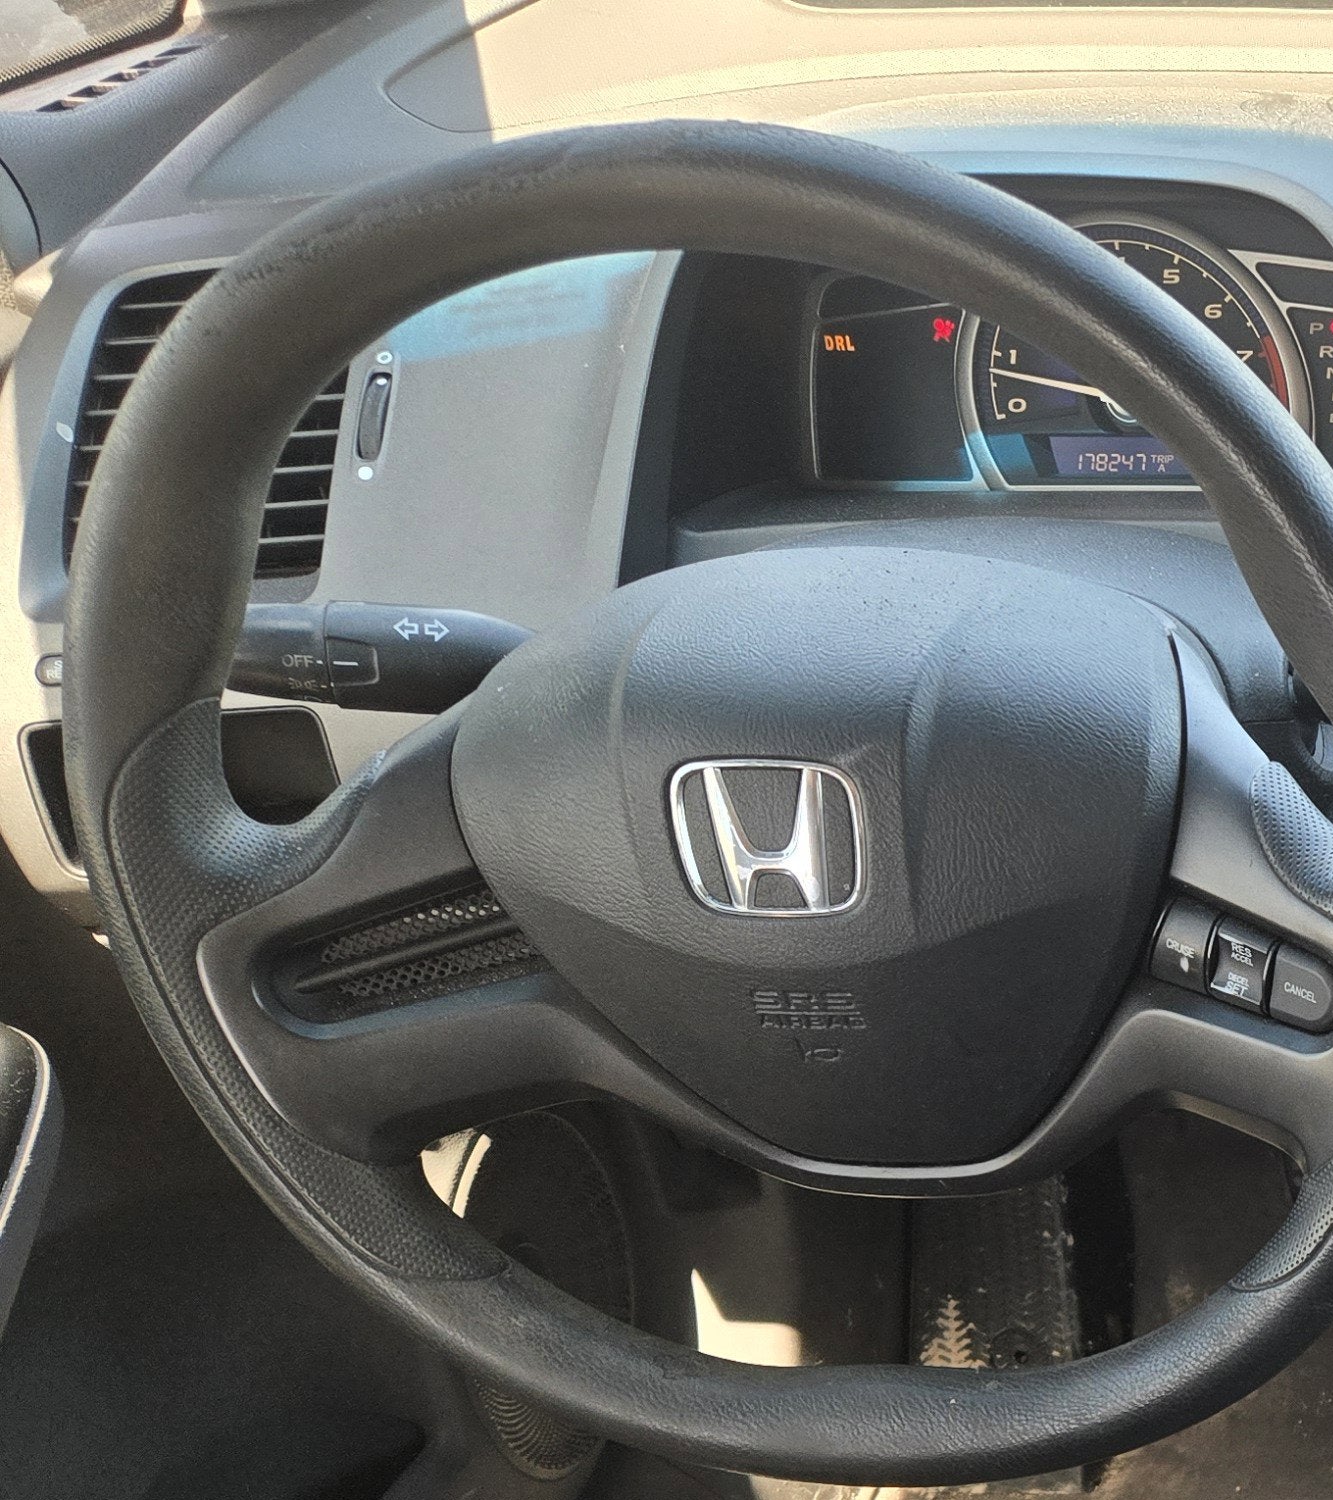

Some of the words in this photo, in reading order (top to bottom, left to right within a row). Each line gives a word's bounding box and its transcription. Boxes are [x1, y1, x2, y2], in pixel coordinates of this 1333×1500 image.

[1162, 268, 1181, 285] 5
[1204, 303, 1223, 319] 6
[1309, 322, 1325, 335] P
[823, 334, 855, 352] DRL
[1009, 349, 1017, 365] 1
[1319, 345, 1333, 358] R
[1007, 398, 1027, 413] 0
[1077, 453, 1147, 472] 178247
[1150, 454, 1174, 464] TRIP
[1157, 463, 1166, 472] A
[281, 653, 315, 667] OFF
[1165, 938, 1196, 959] CRUISE
[1225, 980, 1249, 997] SET
[1283, 982, 1317, 1004] CANCEL
